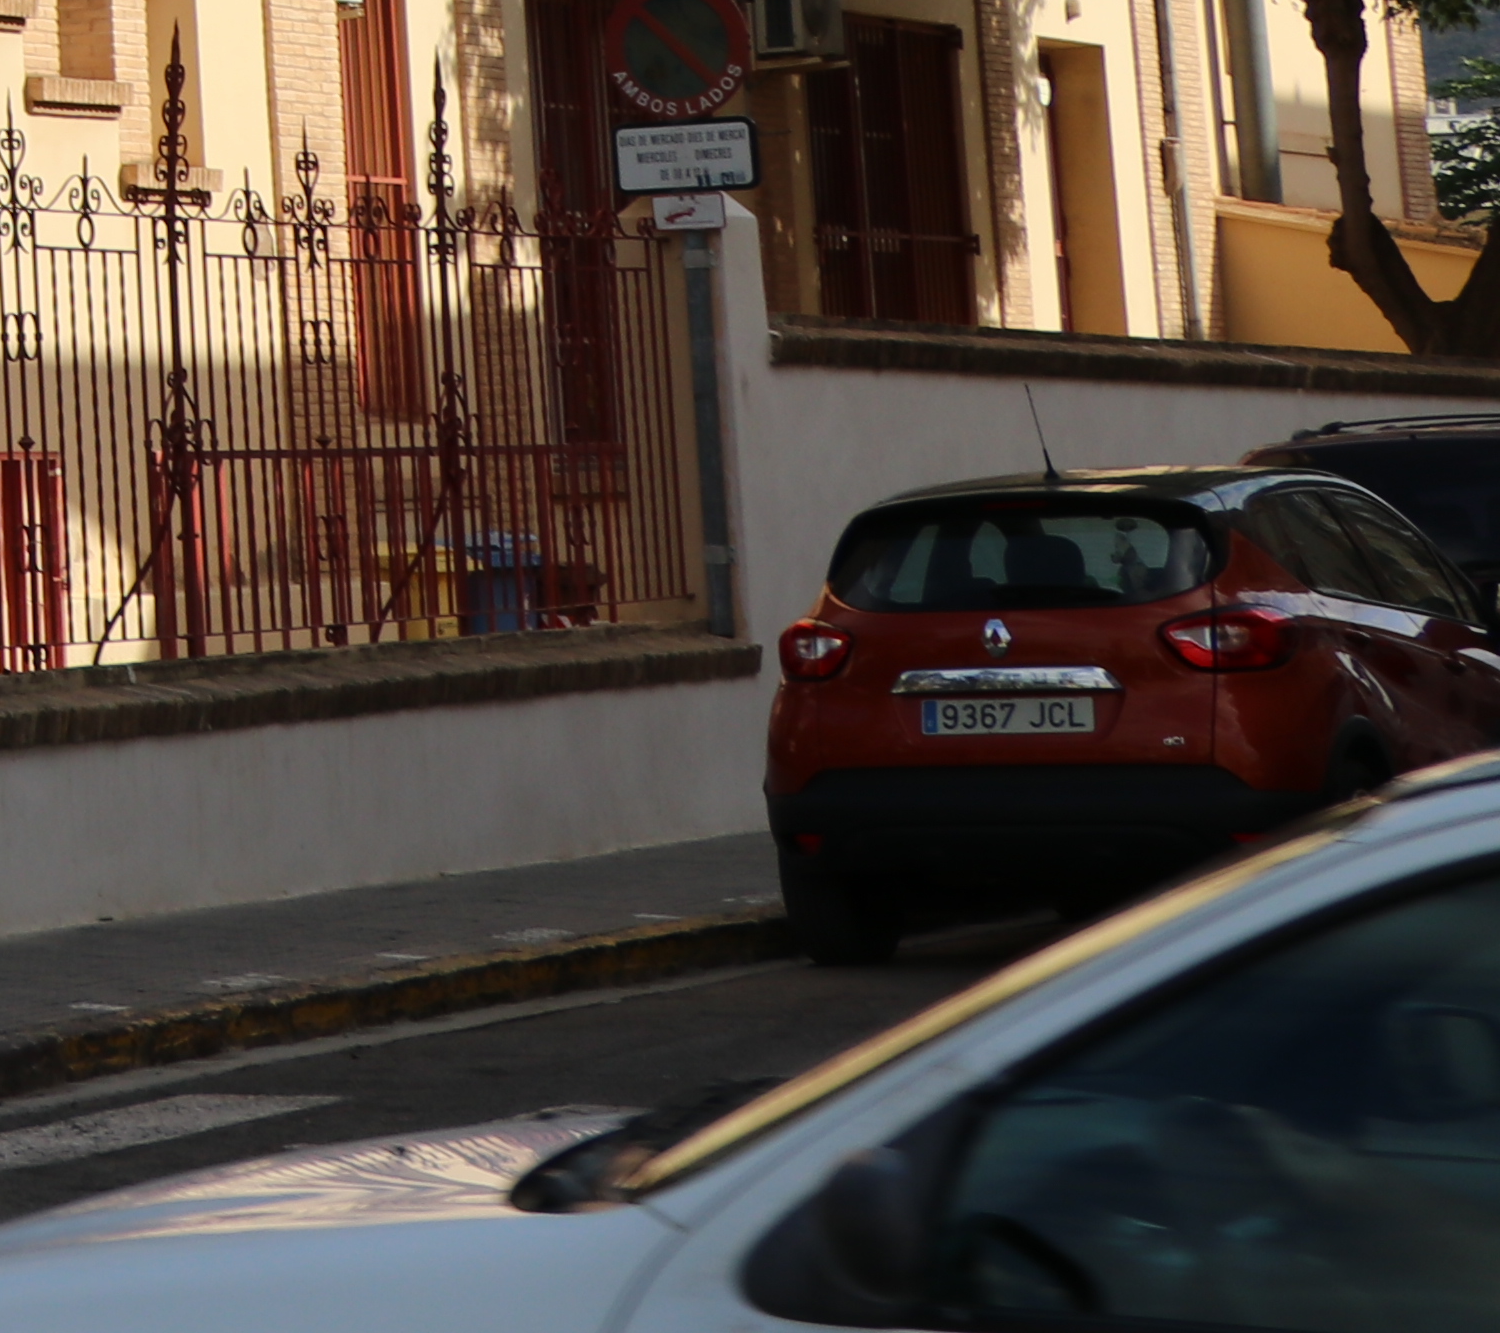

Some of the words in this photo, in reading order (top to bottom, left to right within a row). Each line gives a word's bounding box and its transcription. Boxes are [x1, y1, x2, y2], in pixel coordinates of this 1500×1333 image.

[613, 71, 678, 116] AMBOS
[685, 64, 742, 115] LADOS
[942, 703, 1016, 730] 9367
[1029, 701, 1086, 728] JCL
